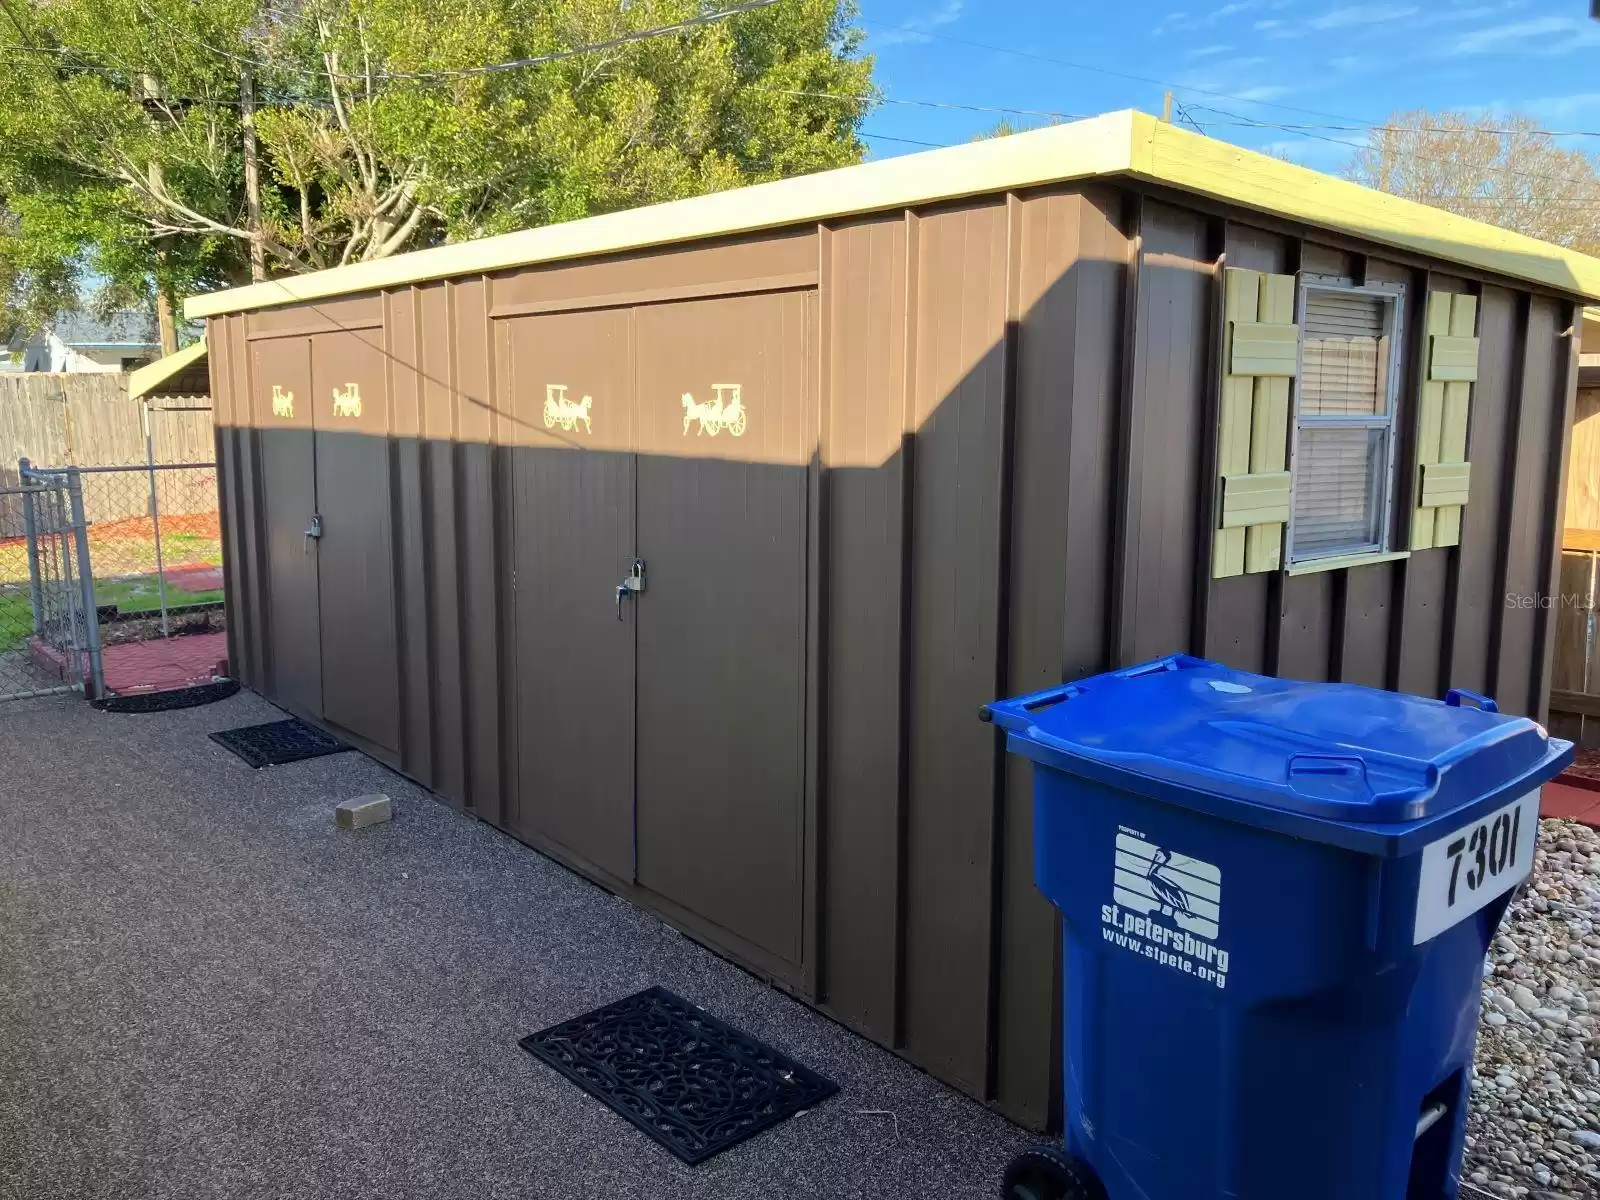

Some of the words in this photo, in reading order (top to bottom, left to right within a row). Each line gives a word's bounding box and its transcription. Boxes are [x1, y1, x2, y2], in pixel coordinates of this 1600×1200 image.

[1447, 804, 1521, 908] 7301
[1101, 904, 1229, 973] st.petersburg
[1102, 927, 1226, 989] www.stpete.org
